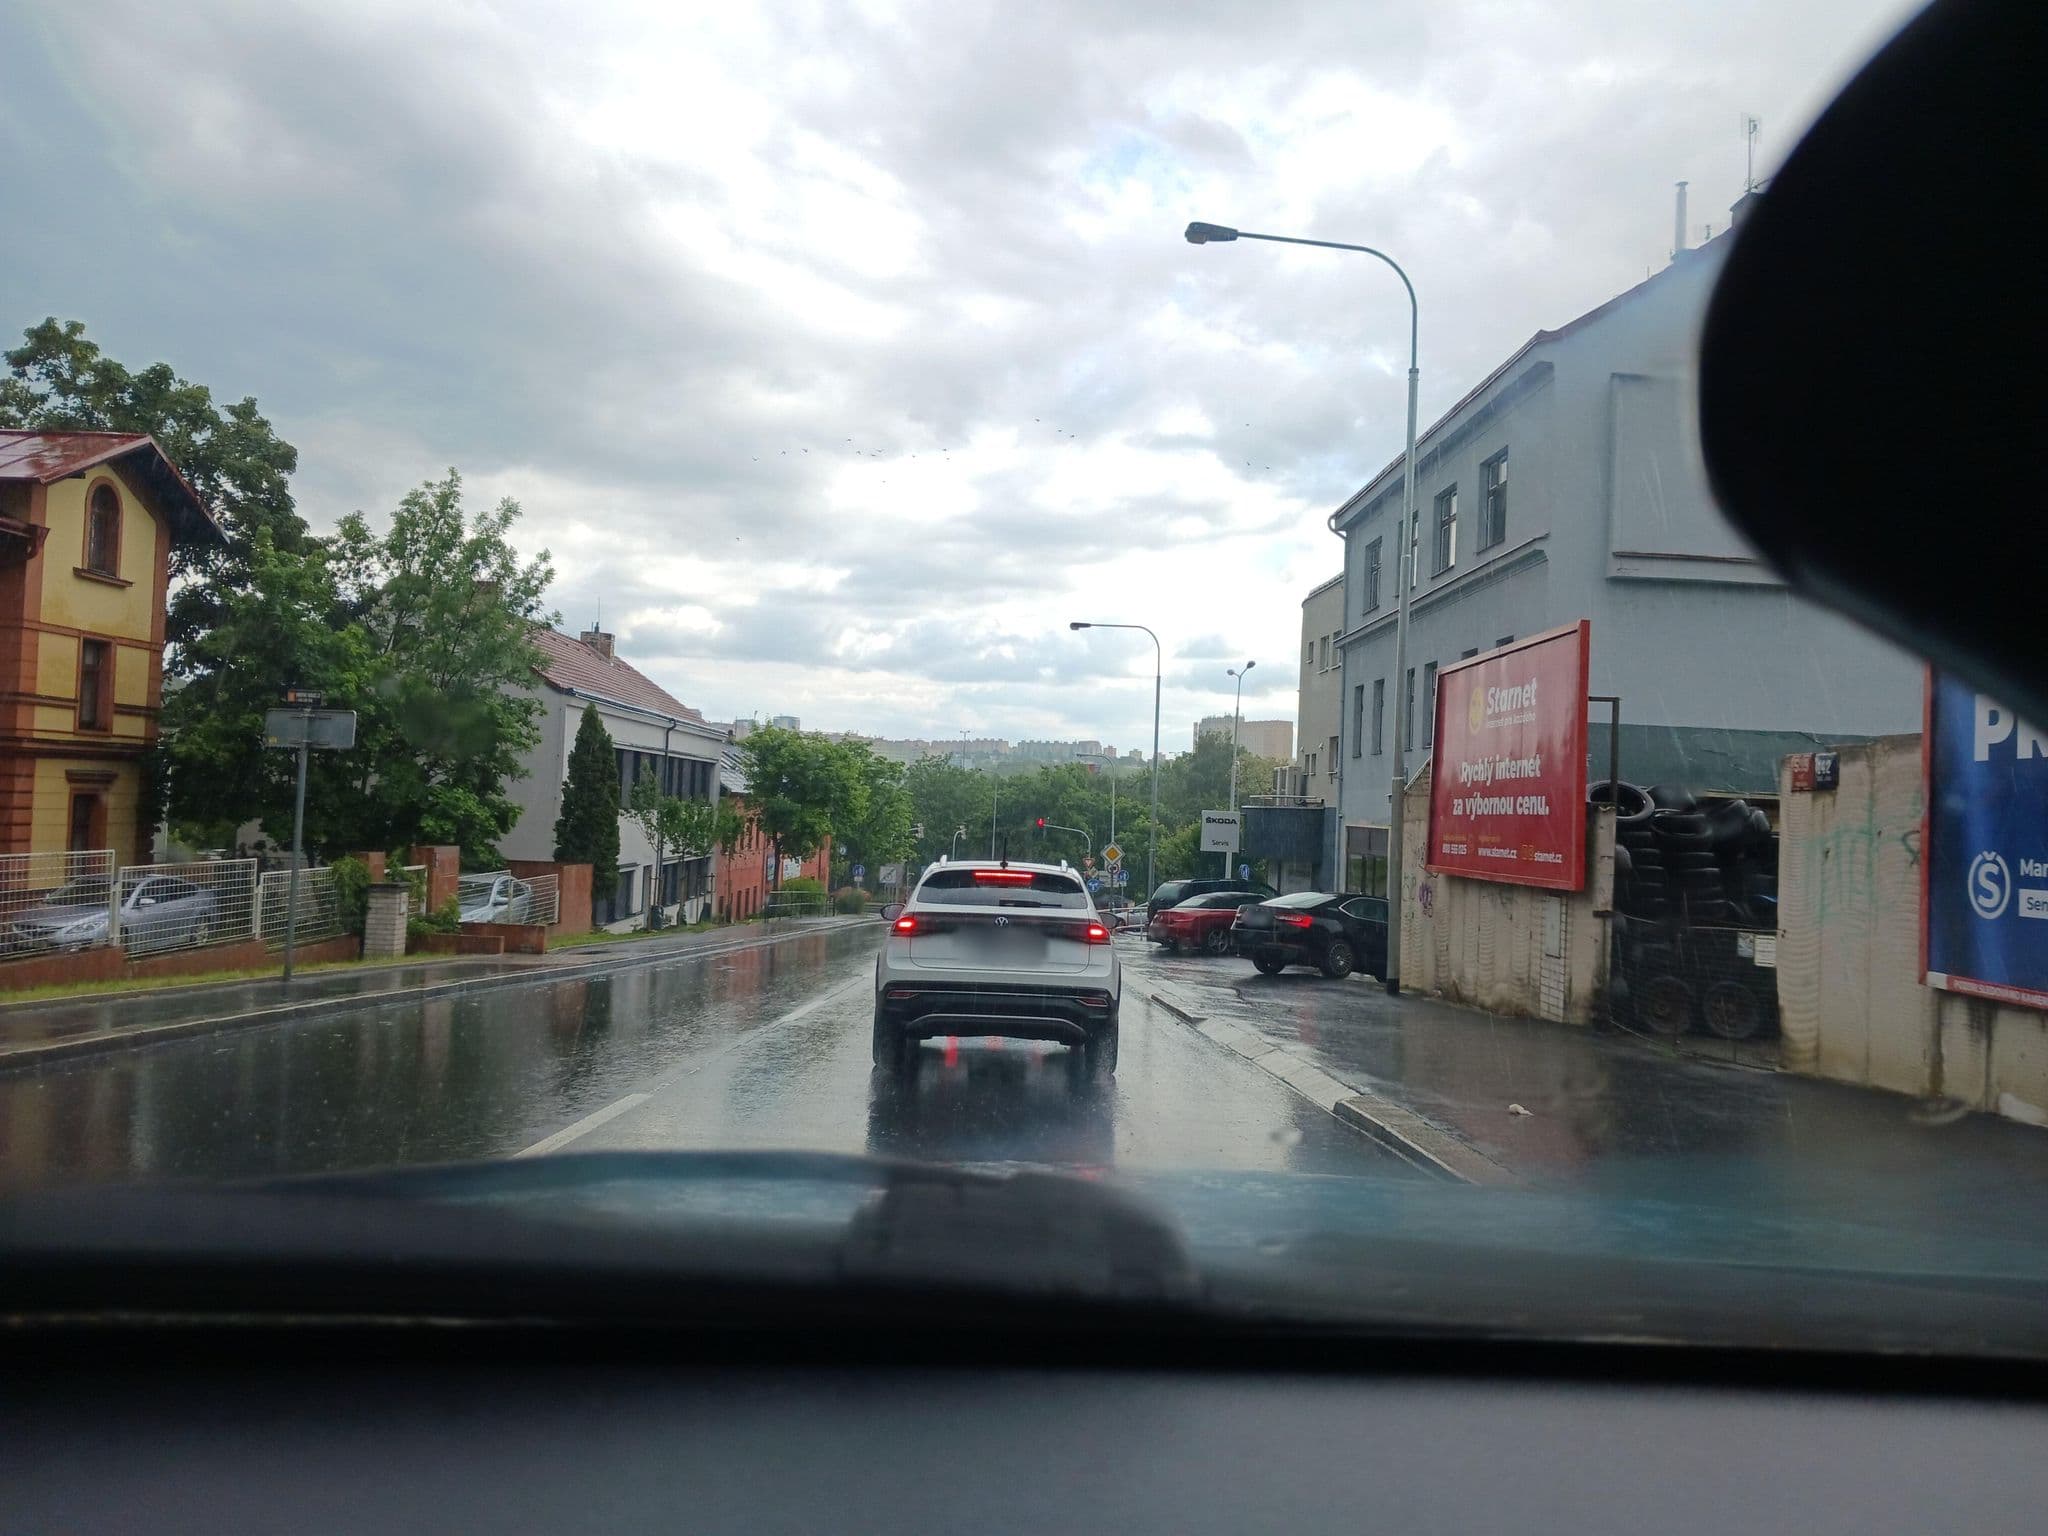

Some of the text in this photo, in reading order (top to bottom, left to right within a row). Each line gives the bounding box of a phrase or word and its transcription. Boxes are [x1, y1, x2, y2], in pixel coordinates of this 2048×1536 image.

[1486, 677, 1537, 716] Starnet
[1461, 754, 1541, 788] Rychlý internet
[1205, 816, 1238, 825] ŠKODA
[1452, 791, 1550, 821] za výbornou cenu.
